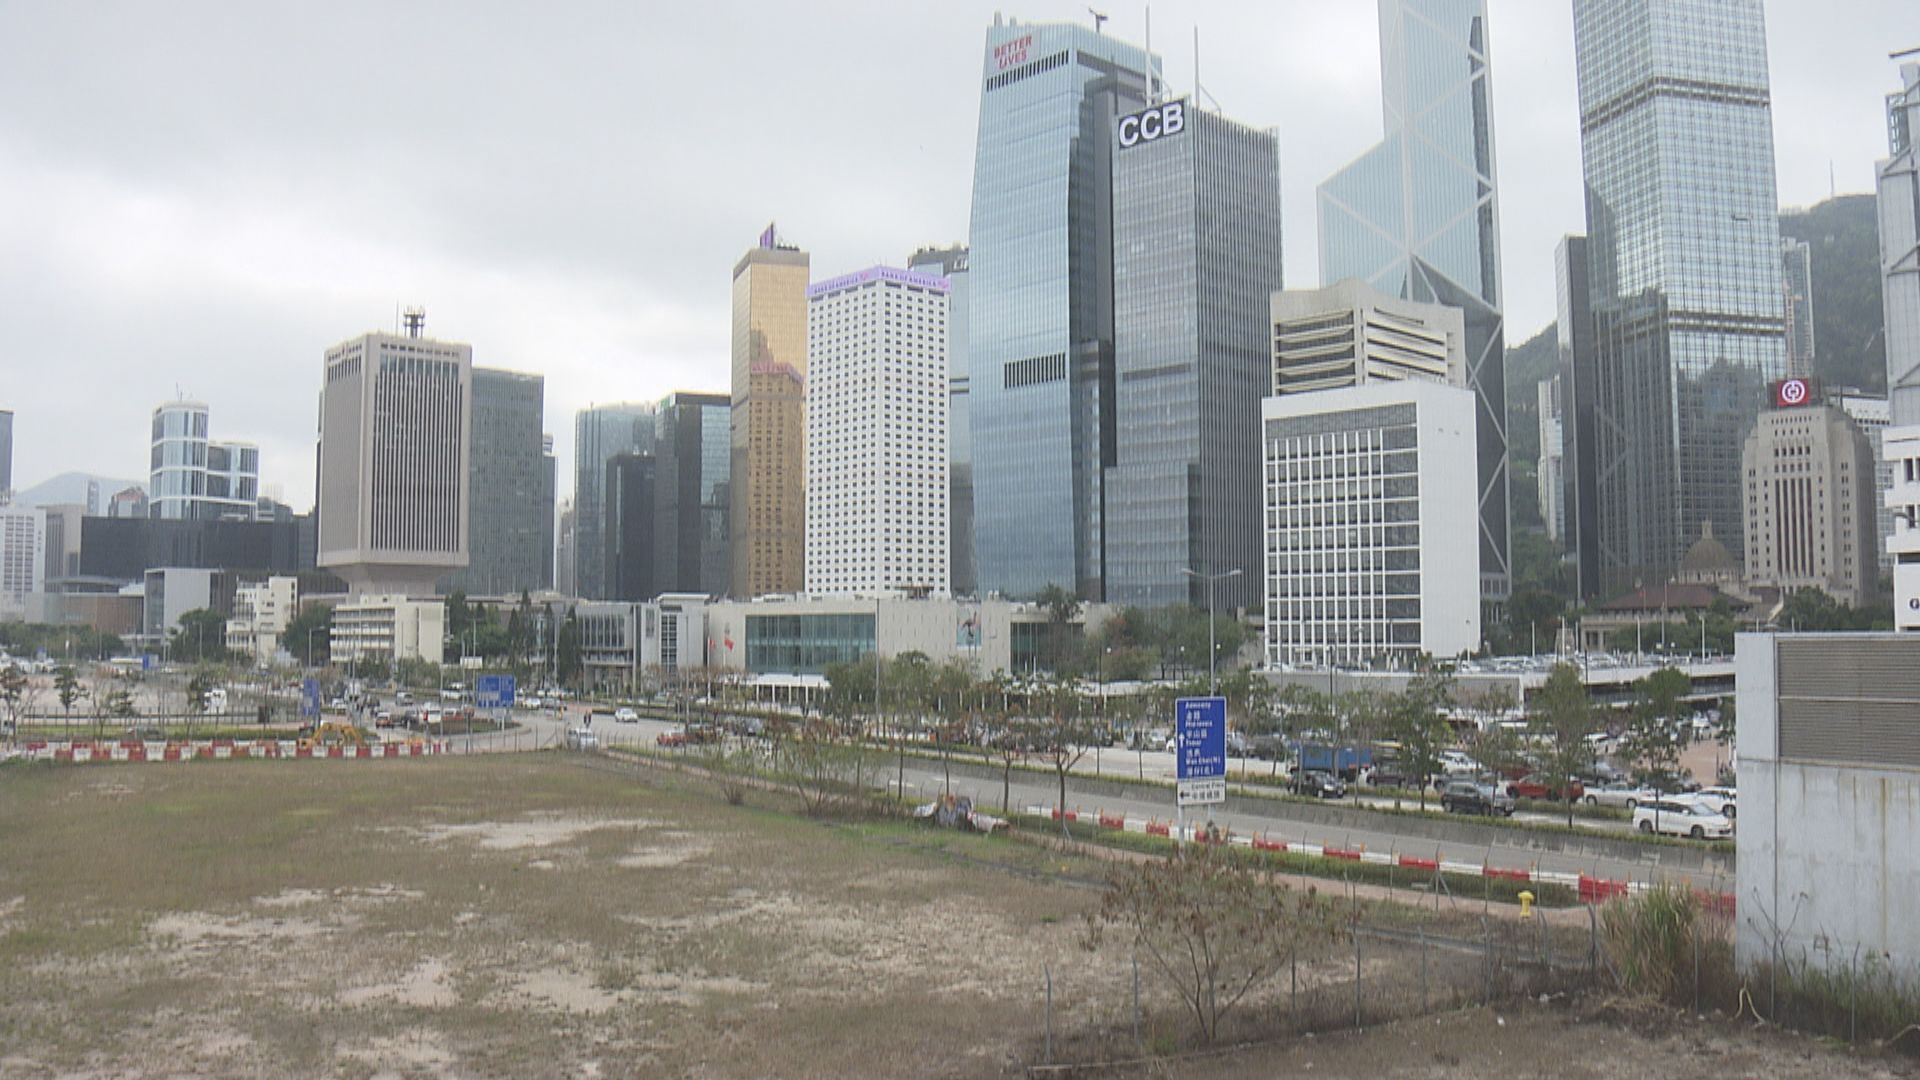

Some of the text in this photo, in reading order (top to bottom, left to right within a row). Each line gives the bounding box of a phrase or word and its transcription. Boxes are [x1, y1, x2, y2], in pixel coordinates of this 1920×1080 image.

[993, 35, 1032, 58] BETTER
[999, 49, 1027, 69] LIVES
[1119, 101, 1183, 146] CCB
